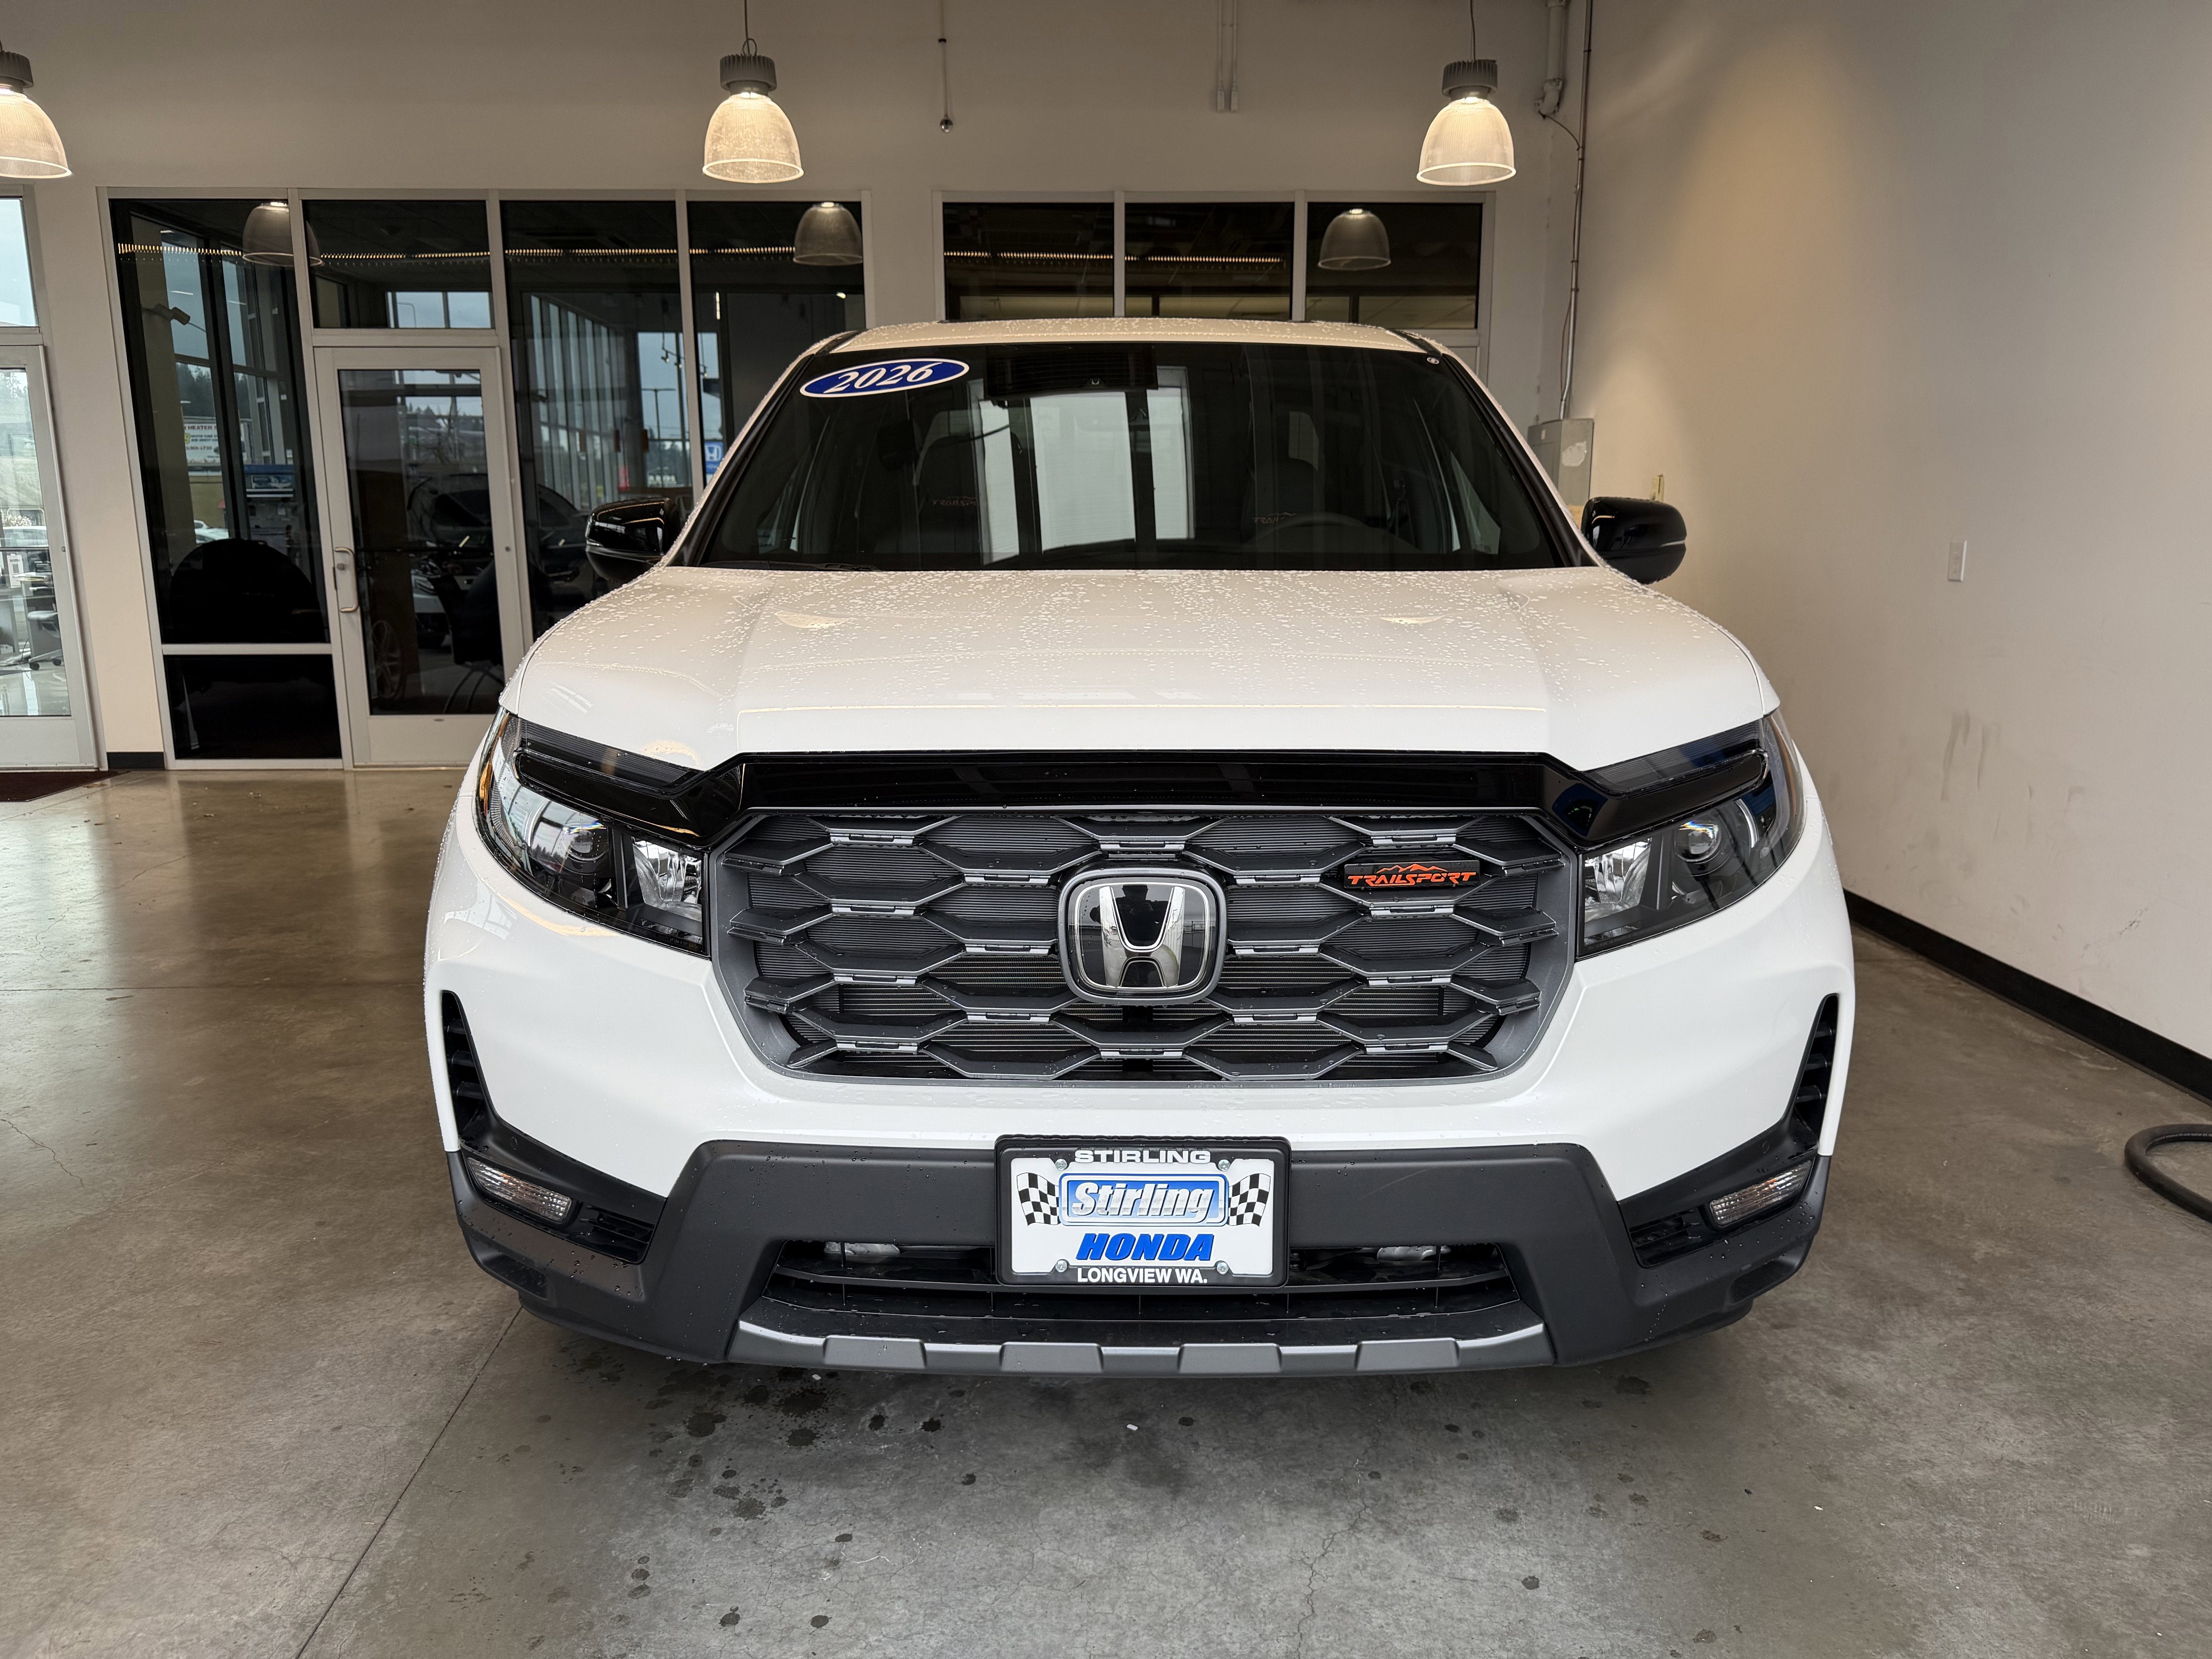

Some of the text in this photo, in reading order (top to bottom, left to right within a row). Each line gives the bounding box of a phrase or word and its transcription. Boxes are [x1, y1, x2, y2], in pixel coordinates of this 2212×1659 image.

[823, 362, 943, 393] 2026
[1348, 872, 1477, 887] TRAILSPORT
[1074, 1149, 1211, 1164] STIRLING
[1072, 1182, 1215, 1223] Stirling
[1076, 1233, 1215, 1262] HONDA
[1077, 1267, 1208, 1284] LONGVIEW WA.
